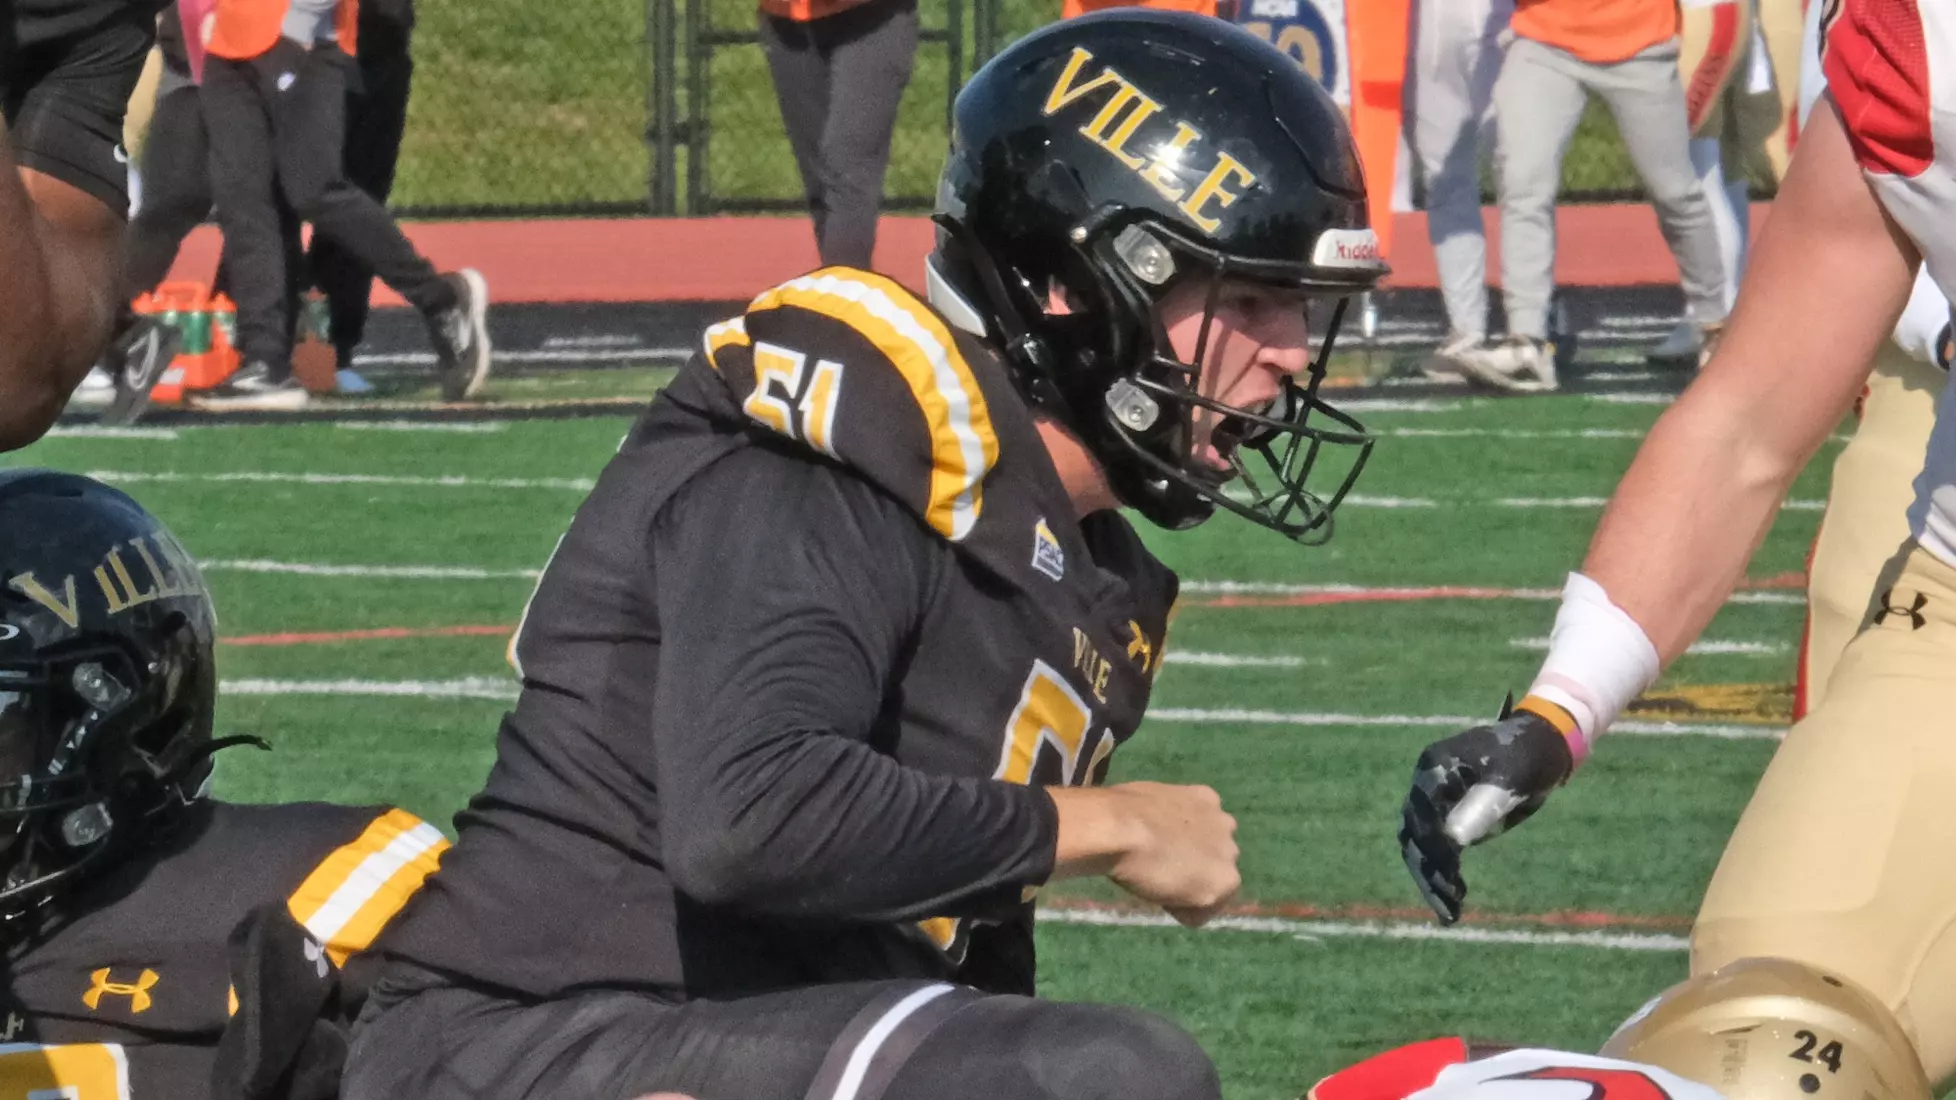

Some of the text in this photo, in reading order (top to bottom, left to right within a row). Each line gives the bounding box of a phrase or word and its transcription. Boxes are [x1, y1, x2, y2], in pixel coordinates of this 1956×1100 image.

[1041, 45, 1257, 235] VILLE
[743, 340, 845, 464] 51
[1787, 1028, 1844, 1074] 24
